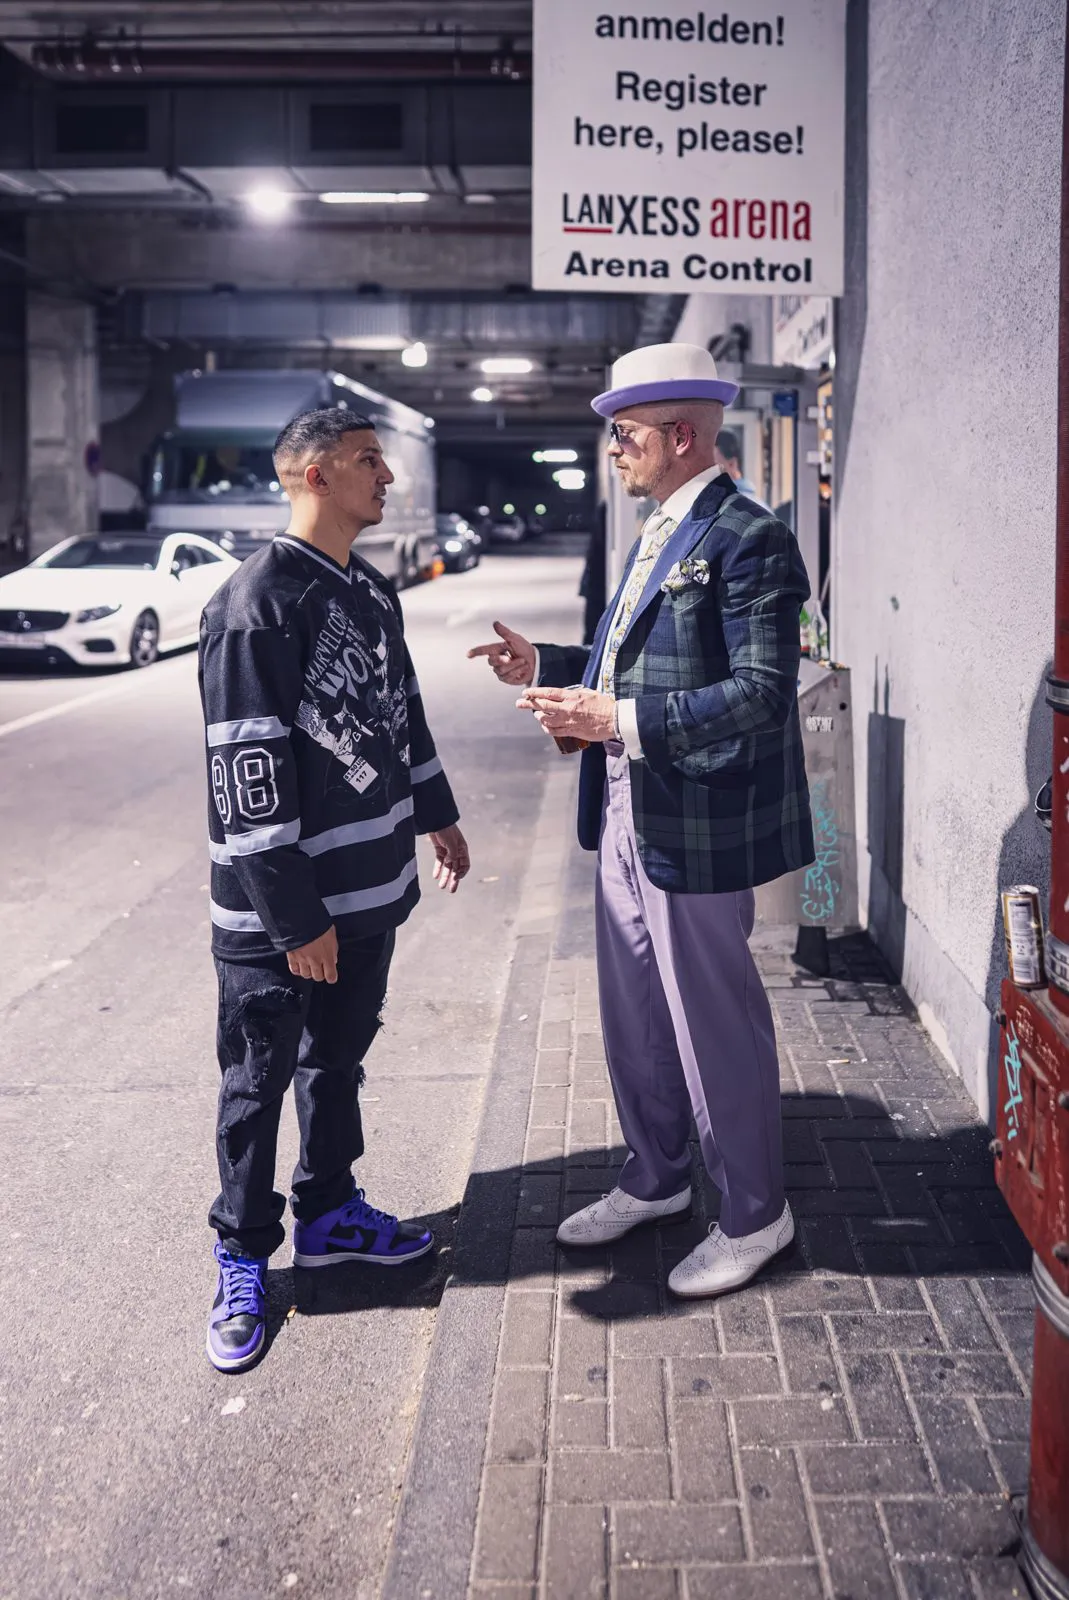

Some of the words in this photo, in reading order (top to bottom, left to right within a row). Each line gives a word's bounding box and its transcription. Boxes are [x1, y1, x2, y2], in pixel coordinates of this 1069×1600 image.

[595, 12, 785, 46] anmelden!
[615, 71, 767, 110] Register
[574, 117, 664, 154] here,
[677, 122, 804, 157] please!
[562, 193, 700, 237] LANXESS
[709, 198, 812, 241] arena
[564, 251, 670, 280] Arena
[683, 254, 812, 283] Control
[305, 629, 342, 685] MARVEL
[211, 747, 279, 825] 88
